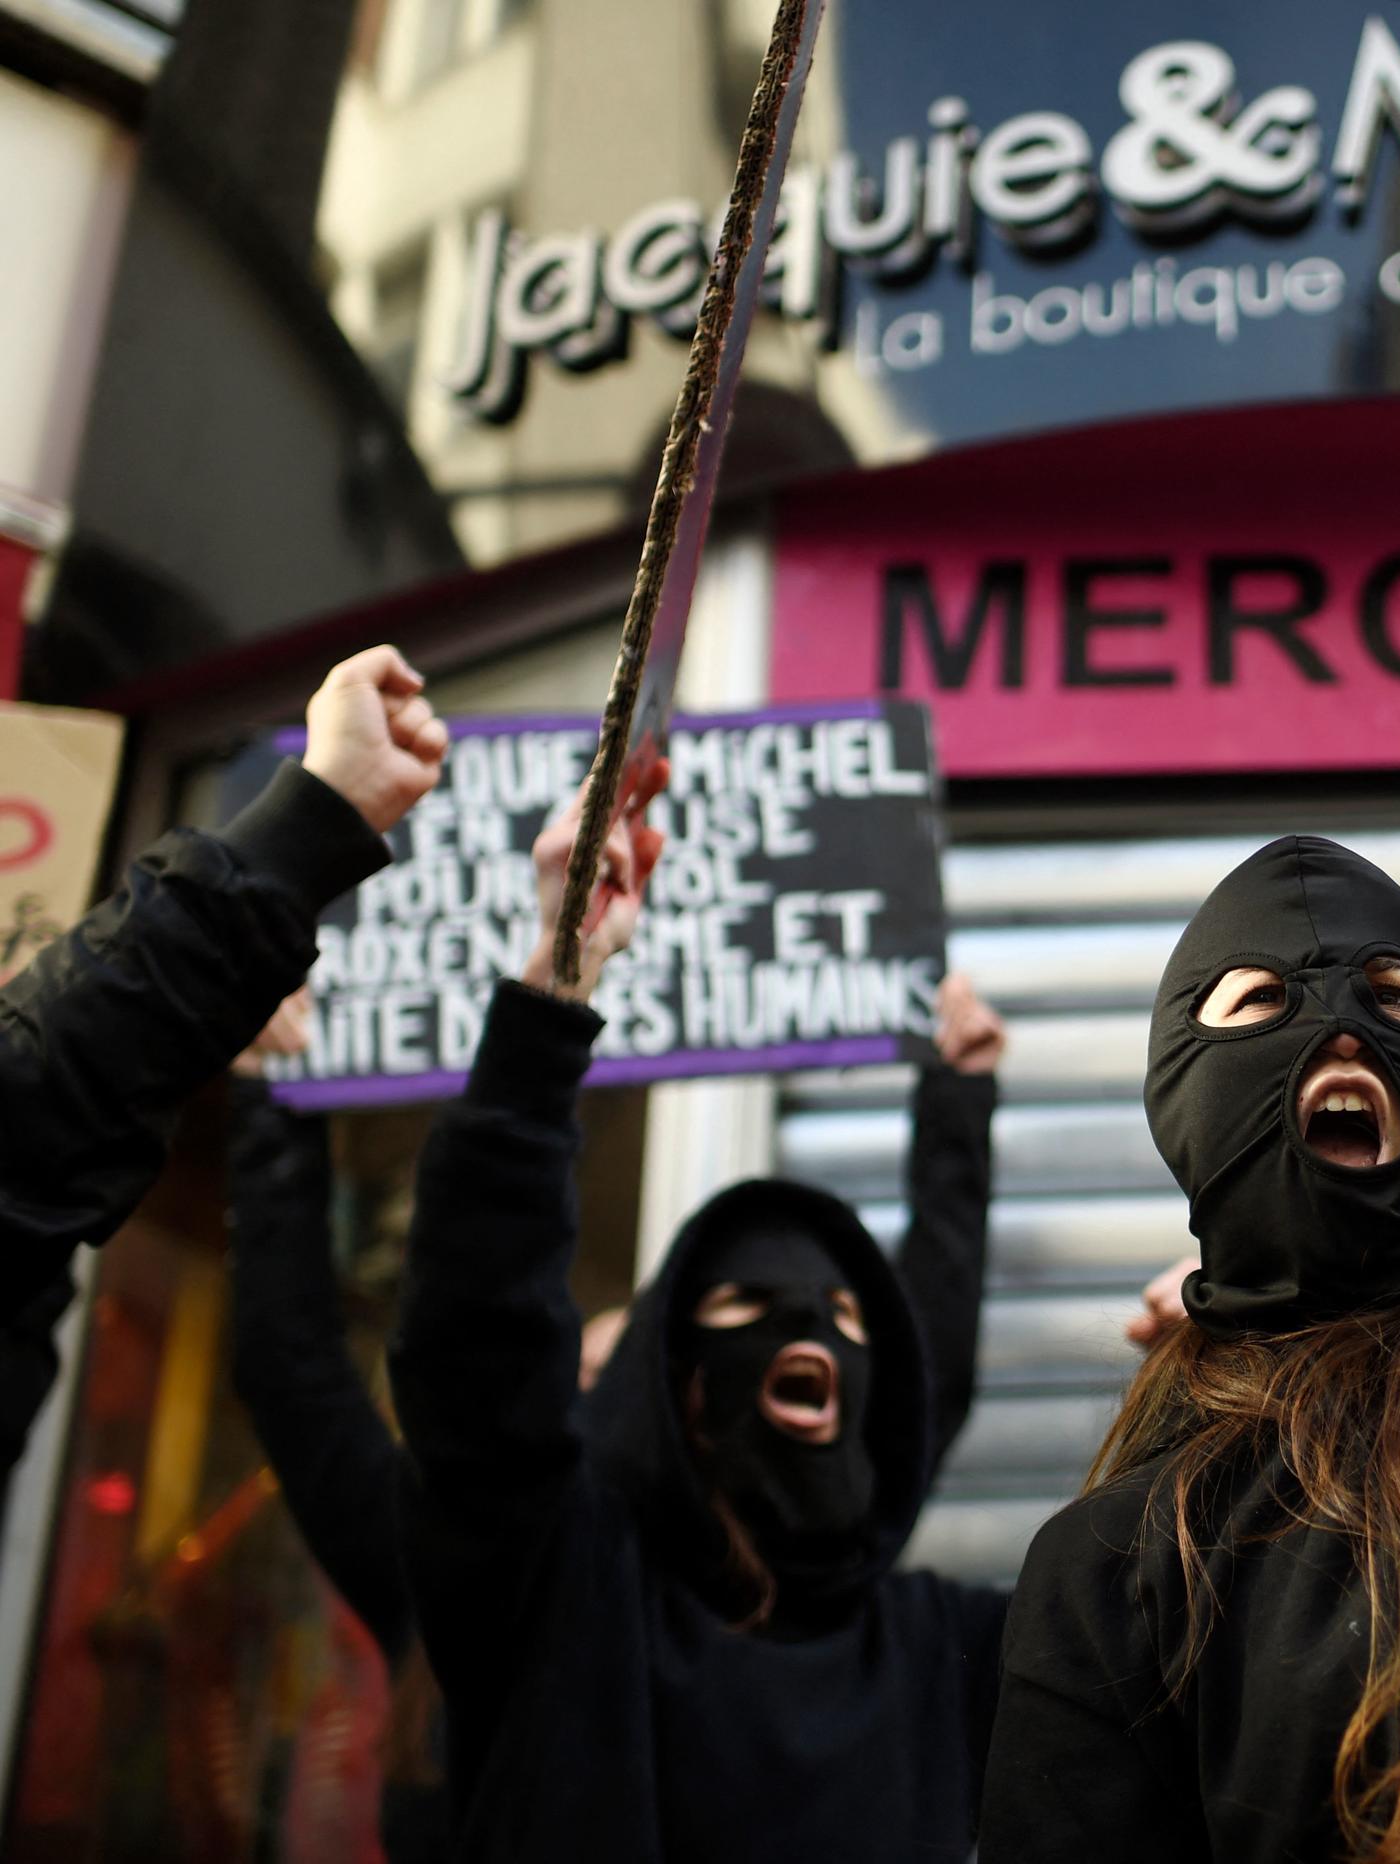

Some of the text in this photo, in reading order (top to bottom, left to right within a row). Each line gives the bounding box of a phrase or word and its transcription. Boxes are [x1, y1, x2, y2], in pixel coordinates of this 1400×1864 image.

[971, 256, 1345, 344] boutique
[774, 889, 887, 962] ET
[683, 955, 942, 1048] HUMAINS
